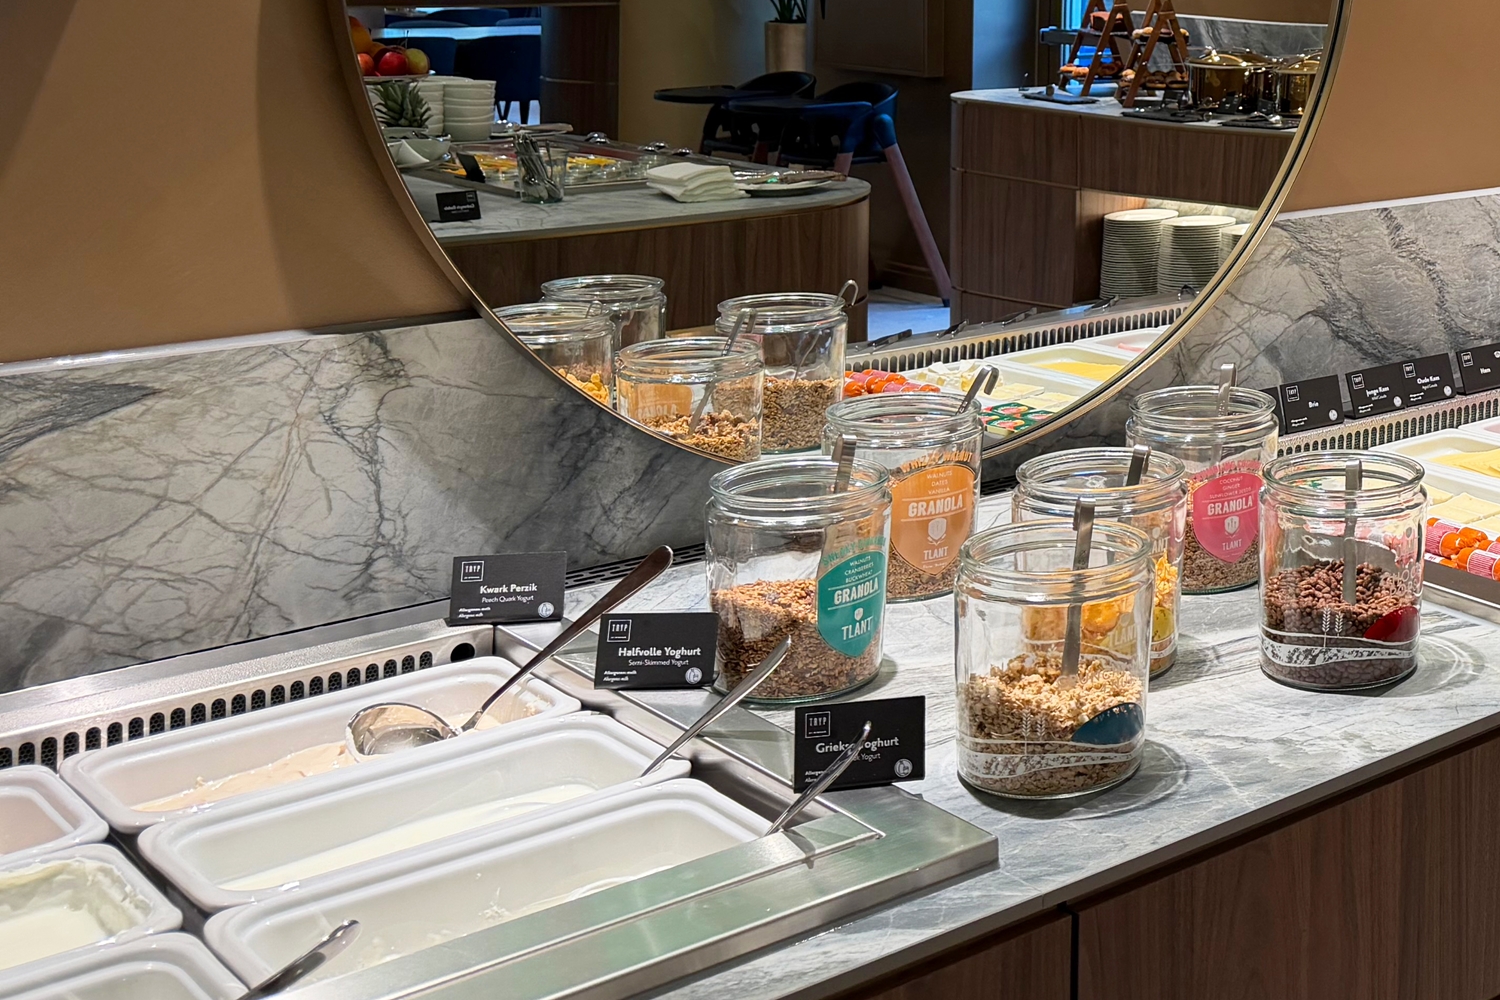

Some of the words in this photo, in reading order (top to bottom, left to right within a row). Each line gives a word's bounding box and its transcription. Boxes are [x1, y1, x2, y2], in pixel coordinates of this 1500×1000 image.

[908, 494, 963, 517] GRANOLA
[1207, 495, 1253, 516] GRANOLA
[1222, 539, 1242, 551] TLANT
[923, 546, 949, 560] TLANT
[480, 585, 508, 594] Kwark
[510, 583, 538, 592] Perzik
[834, 577, 879, 605] GRANOLA
[517, 595, 534, 603] Yogurt
[841, 615, 873, 640] TLANT
[618, 647, 662, 656] Halfvolle
[664, 646, 702, 659] Yoghurt
[671, 659, 689, 667] Yogurt
[860, 737, 899, 752] oghurt
[861, 753, 881, 762] Yogurt
